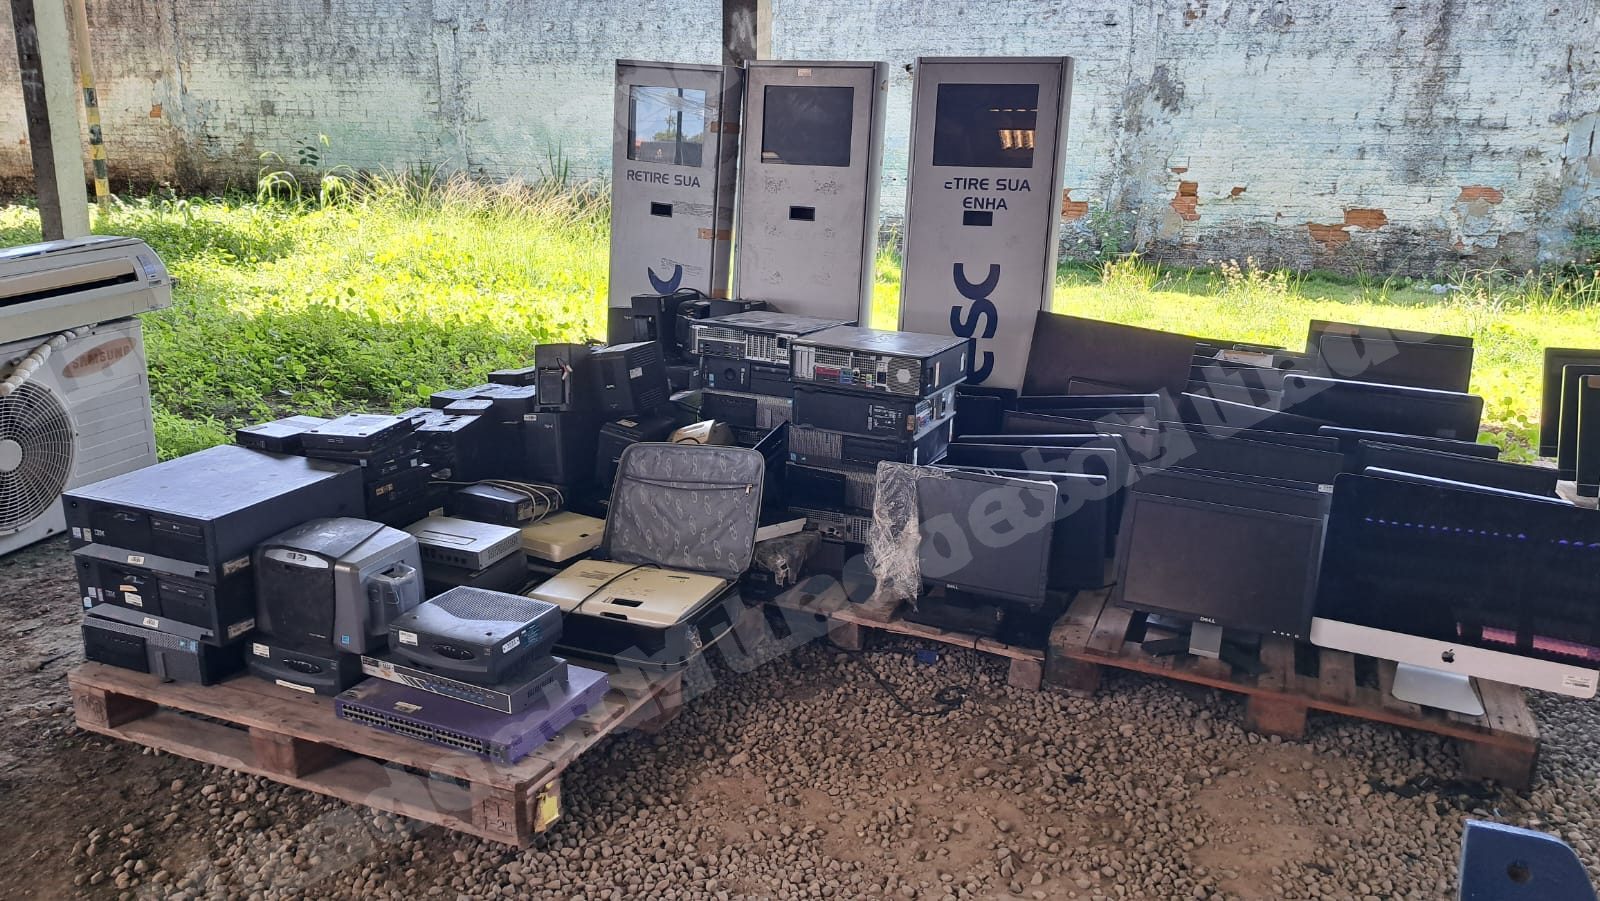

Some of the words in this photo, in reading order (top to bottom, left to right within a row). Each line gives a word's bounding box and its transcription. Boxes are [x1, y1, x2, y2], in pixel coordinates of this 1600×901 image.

[627, 169, 669, 184] RETIRE
[674, 174, 701, 188] SUA
[996, 178, 1031, 192] SUA
[962, 196, 1008, 211] ENHA
[1199, 616, 1216, 625] DELL
